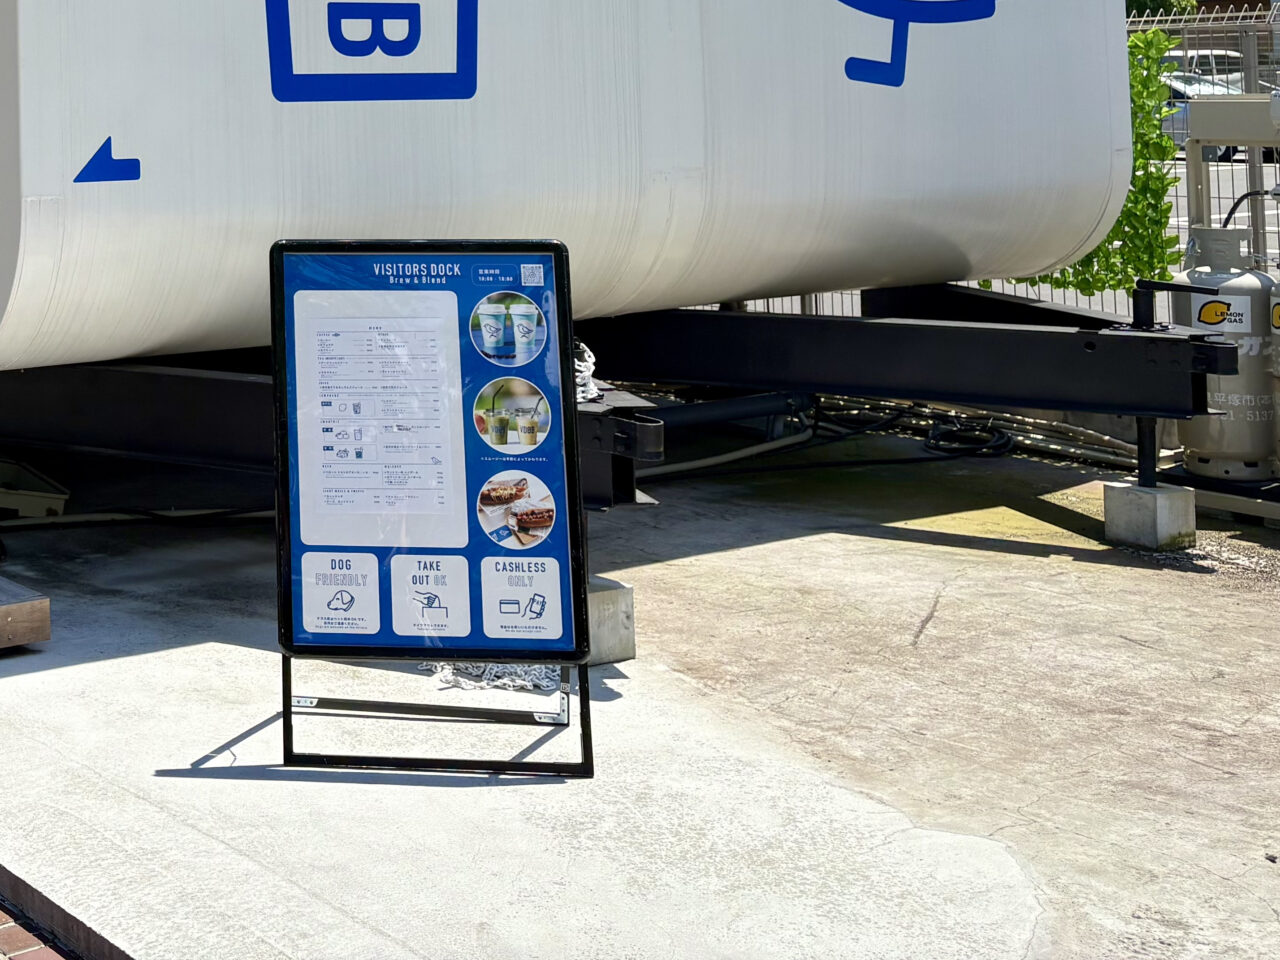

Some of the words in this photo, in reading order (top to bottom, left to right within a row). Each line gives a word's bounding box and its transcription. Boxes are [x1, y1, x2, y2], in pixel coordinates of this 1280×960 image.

[373, 263, 428, 276] VISITORS
[431, 263, 461, 276] DOCK
[389, 276, 412, 284] Brew
[413, 276, 419, 284] &
[422, 276, 447, 284] Blend
[1214, 310, 1244, 318] LEMON
[330, 559, 352, 571] DOG
[417, 561, 442, 572] TAKE
[495, 562, 546, 573] CASHLESS
[315, 573, 368, 587] FRIENDLY
[411, 575, 430, 586] OUT
[433, 575, 448, 586] OK
[507, 575, 534, 587] ONLY
